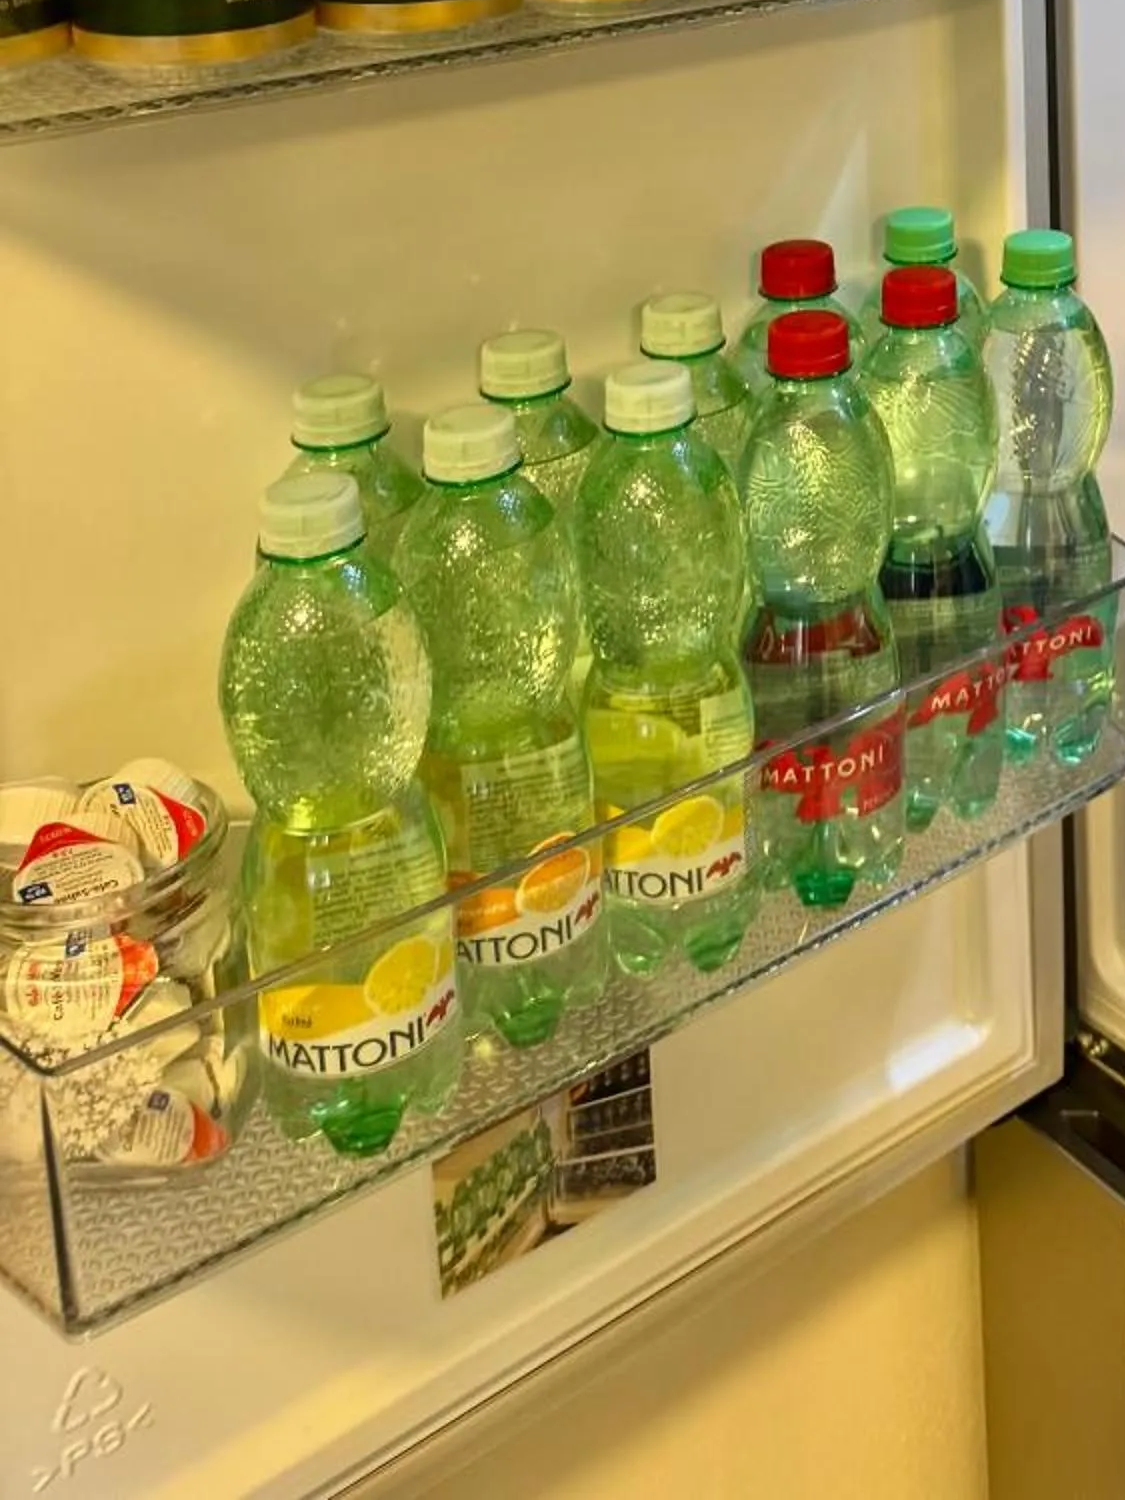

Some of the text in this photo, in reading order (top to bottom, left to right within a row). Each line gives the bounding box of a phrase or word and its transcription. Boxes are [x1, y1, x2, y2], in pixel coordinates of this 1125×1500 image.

[1007, 626, 1093, 658] TTONI
[761, 745, 885, 788] MATTONI
[603, 865, 705, 898] ATTONI
[456, 915, 573, 966] ATTONI
[268, 1016, 426, 1073] MATTONI
